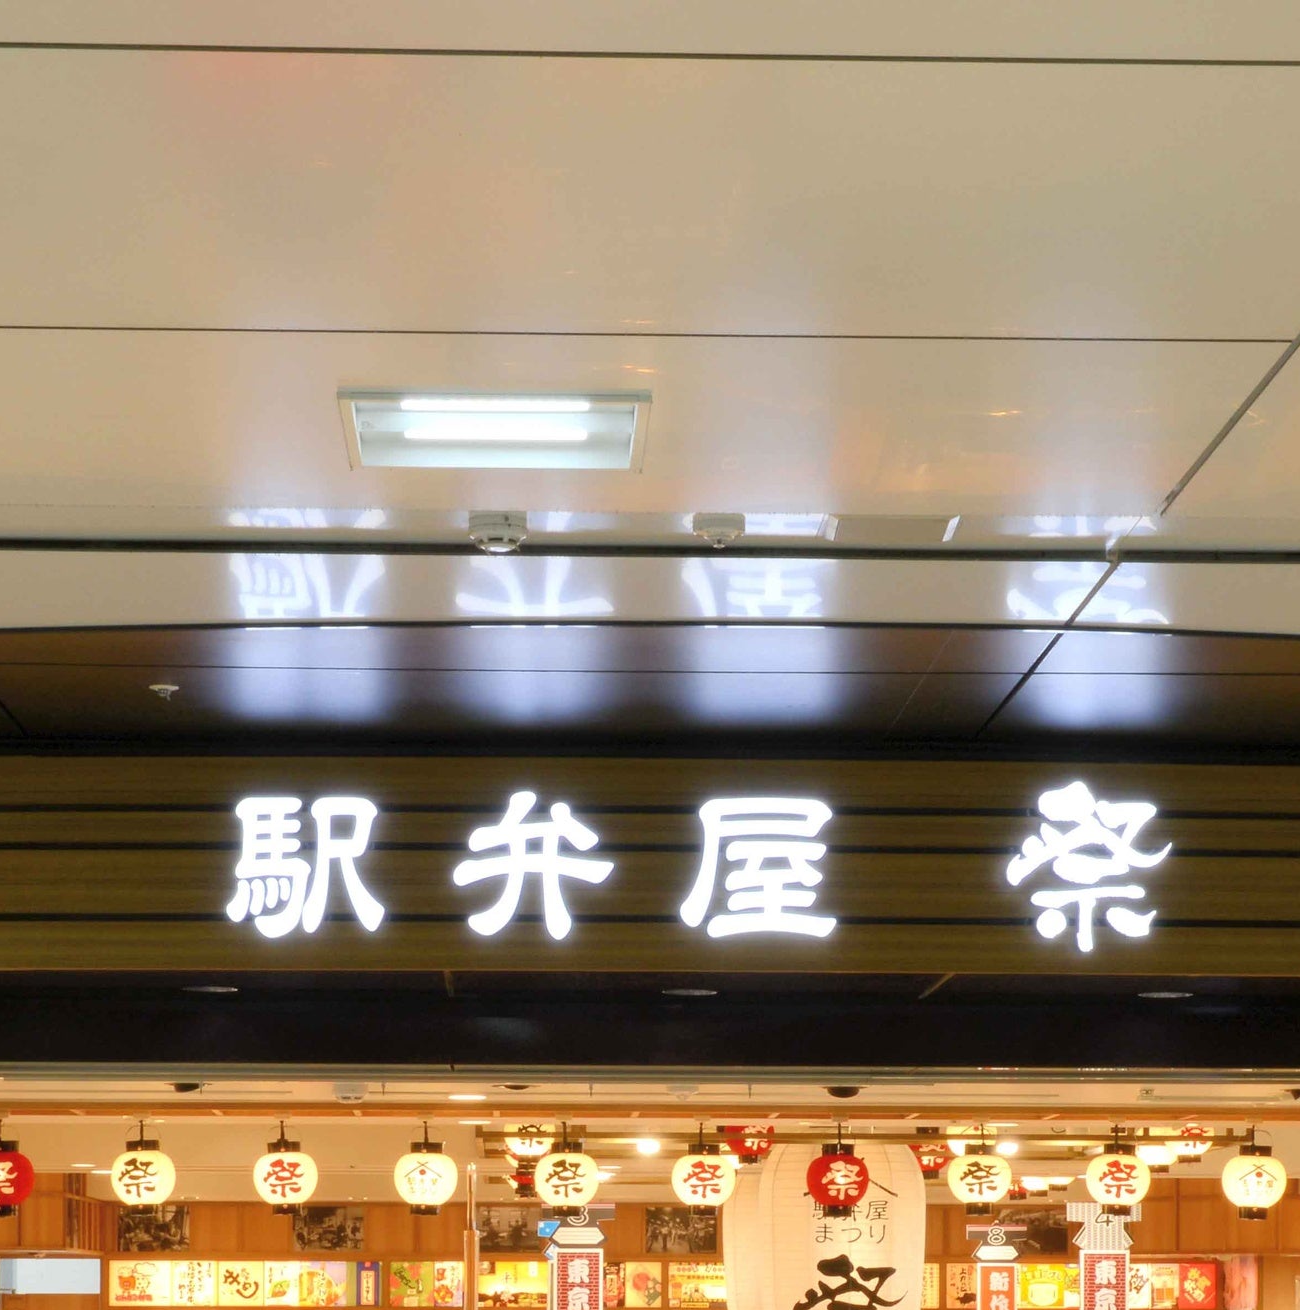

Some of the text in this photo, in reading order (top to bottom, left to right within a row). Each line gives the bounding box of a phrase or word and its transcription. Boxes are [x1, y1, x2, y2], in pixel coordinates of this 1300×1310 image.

[225, 779, 1173, 954] 駅弁屋 祭
[117, 1157, 157, 1199] 祭
[263, 1158, 305, 1199] 祭
[545, 1159, 587, 1198] 祭
[682, 1159, 725, 1199] 祭
[821, 1159, 864, 1201] 祭
[959, 1160, 1001, 1195] 祭
[1098, 1159, 1139, 1198] 祭
[815, 1223, 887, 1244] まつり
[987, 1225, 1007, 1246] 8
